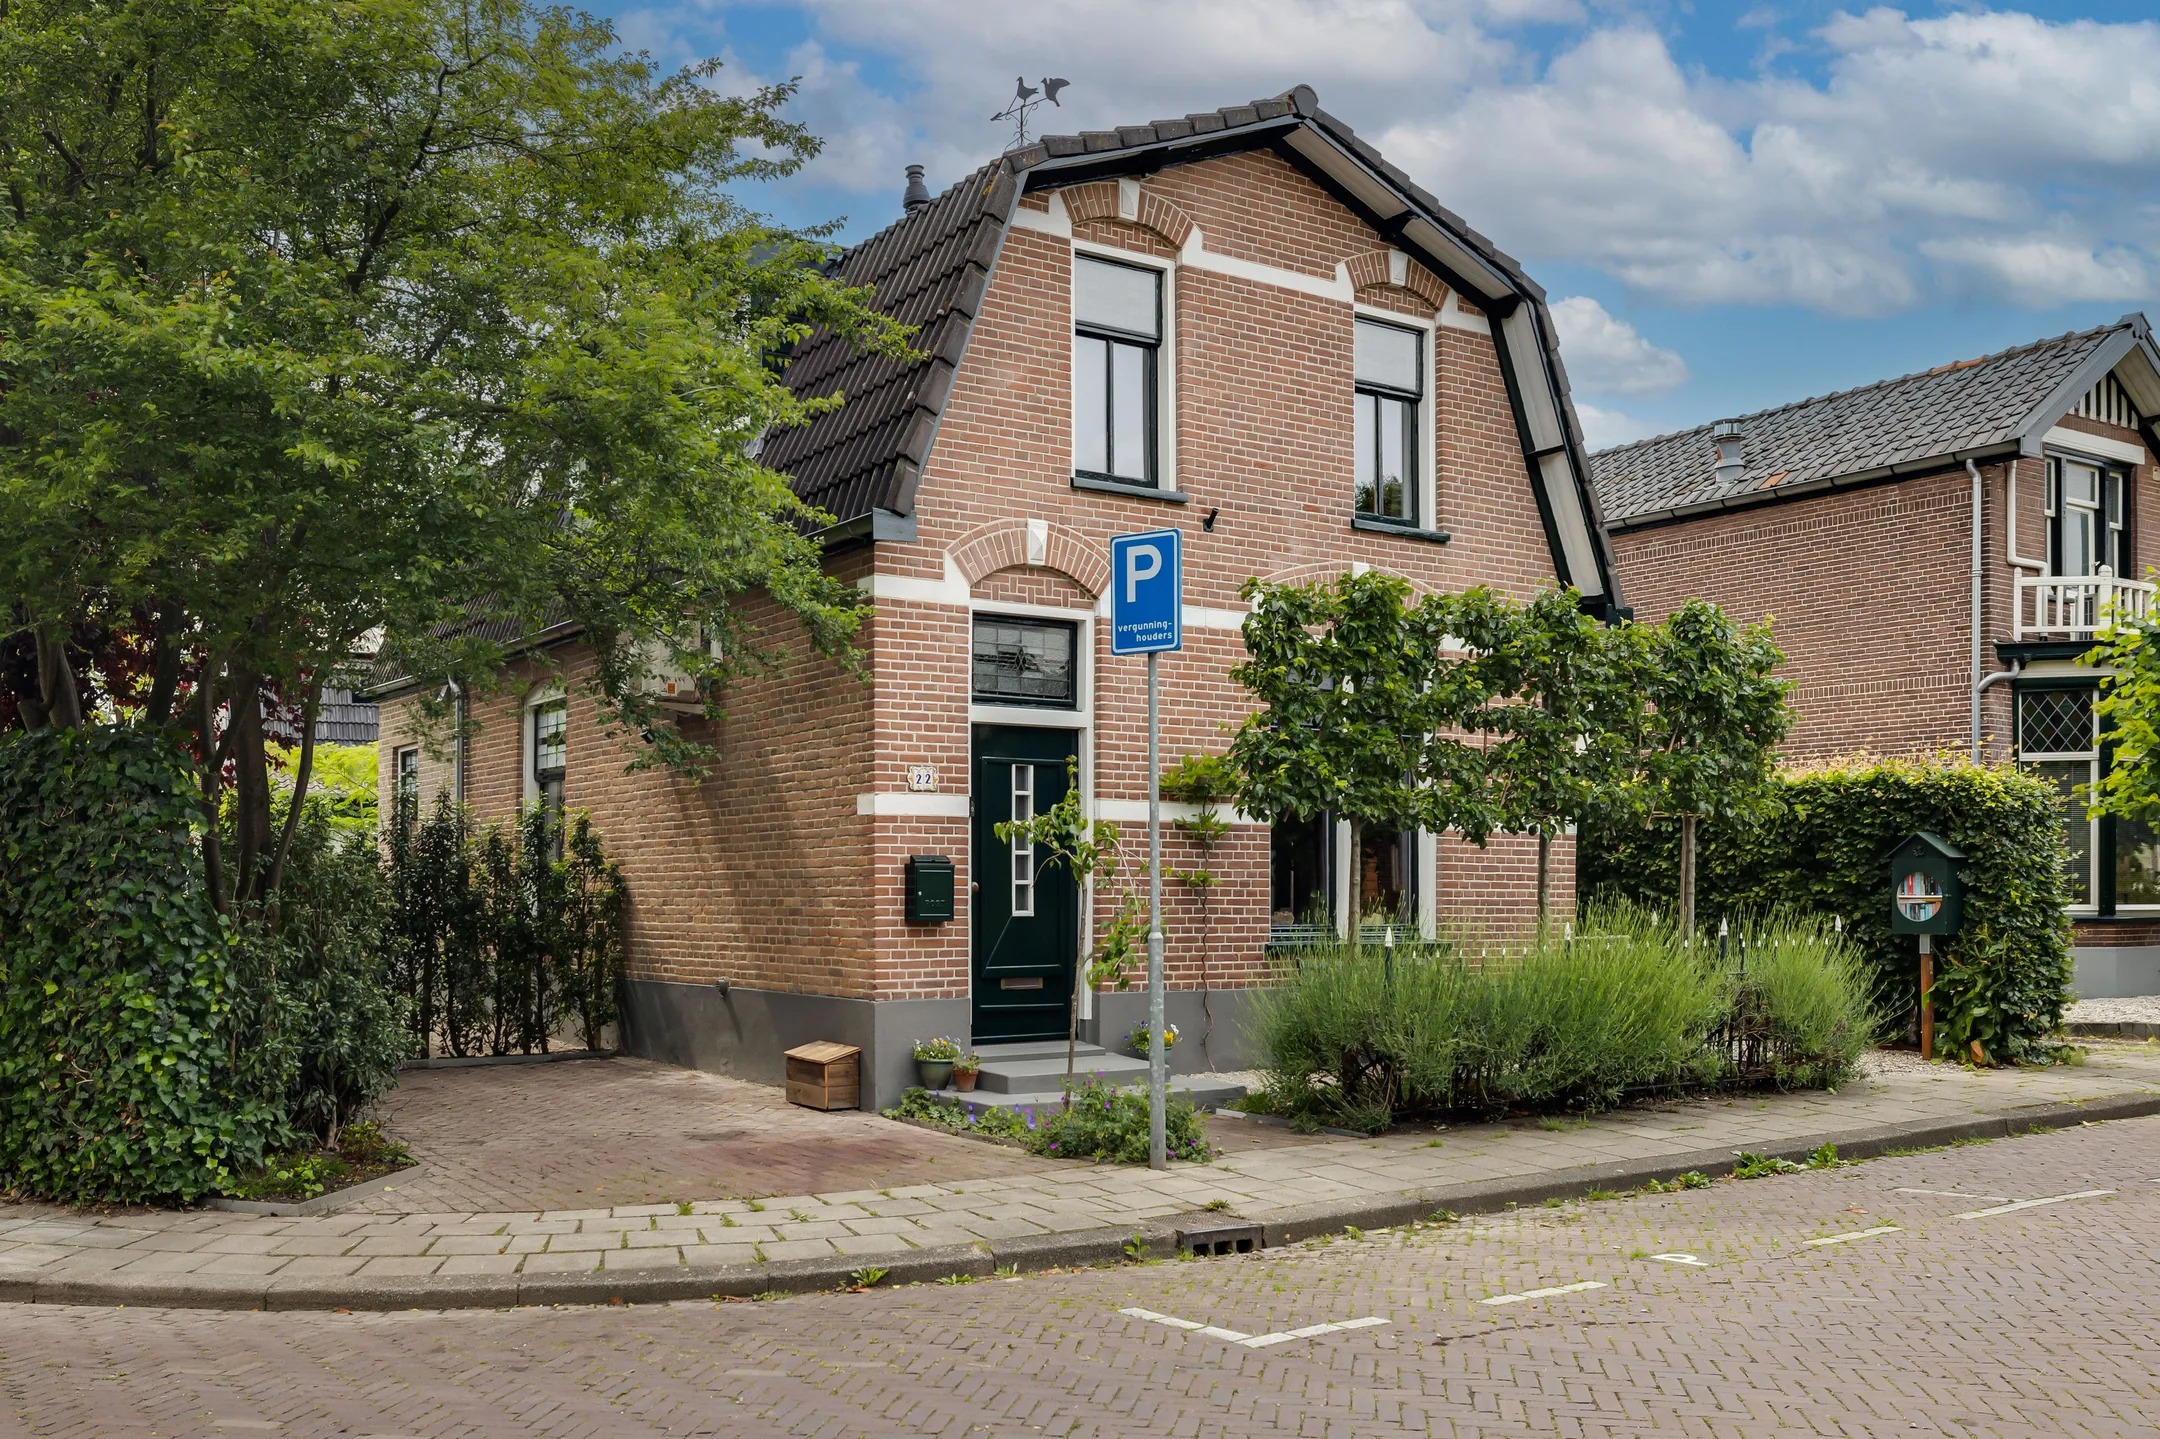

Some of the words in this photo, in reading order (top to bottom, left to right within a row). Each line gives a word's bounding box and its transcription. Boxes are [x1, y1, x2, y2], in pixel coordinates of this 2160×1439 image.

[1127, 544, 1162, 603] P
[1118, 620, 1172, 633] vergunning-
[1136, 631, 1172, 642] houders
[915, 773, 932, 785] 22
